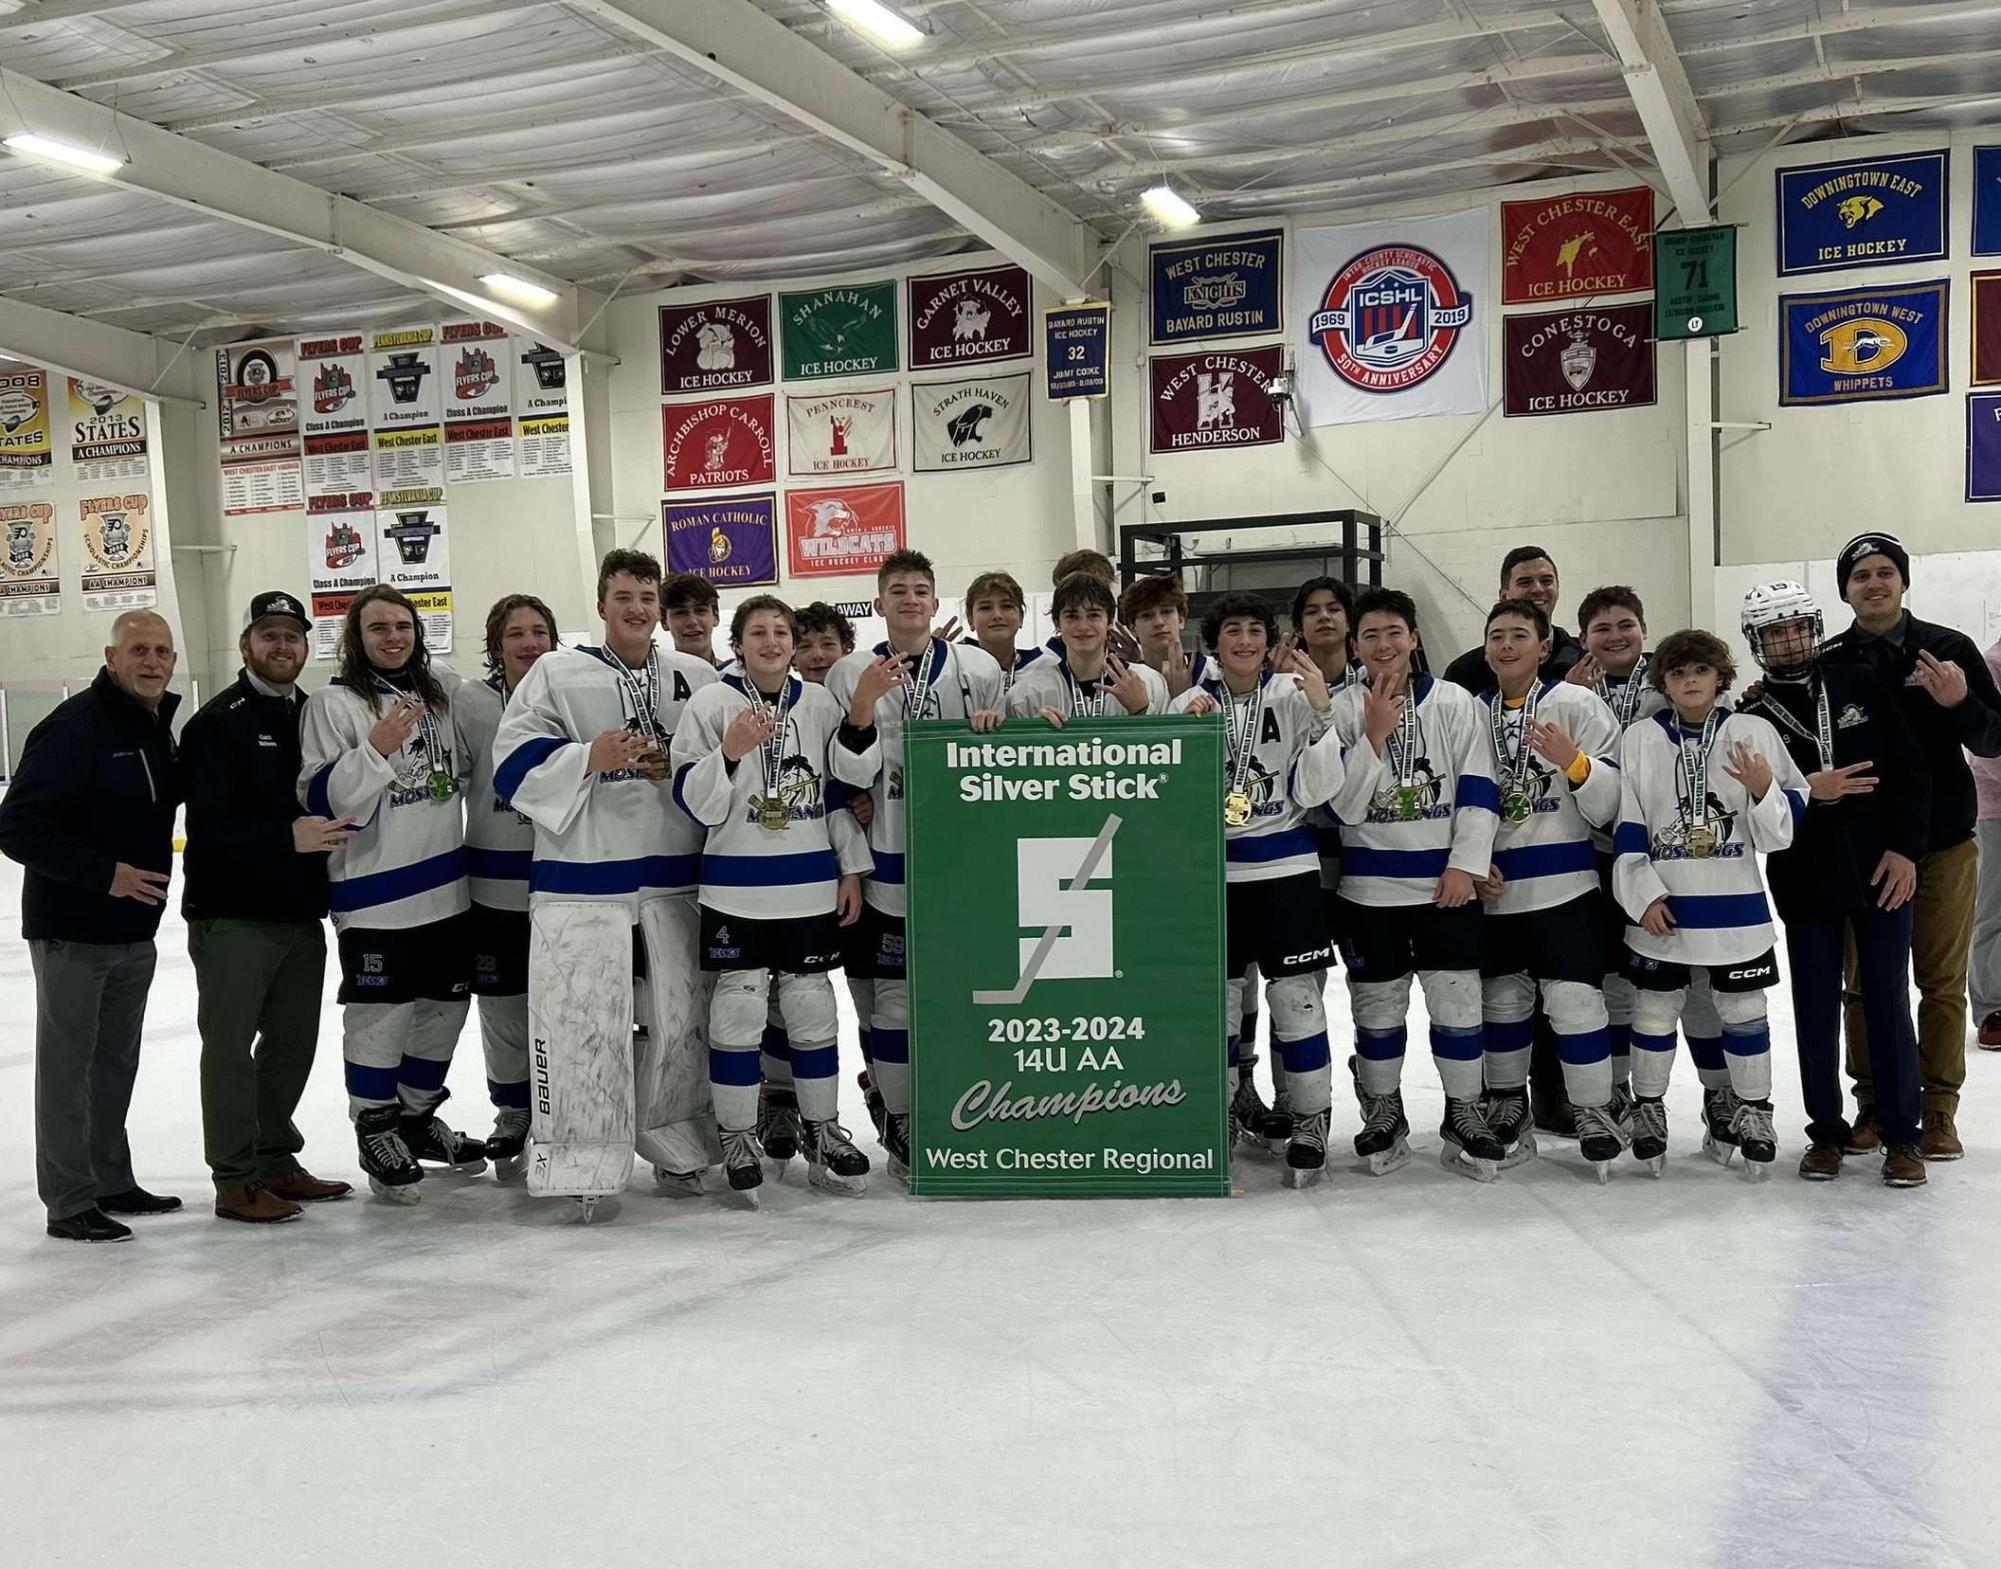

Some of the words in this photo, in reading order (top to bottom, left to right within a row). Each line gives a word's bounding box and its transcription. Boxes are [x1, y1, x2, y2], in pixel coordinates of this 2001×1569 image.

[1801, 172, 1887, 210] DOWNINGTOWN
[1890, 173, 1923, 199] EAST
[1506, 223, 1536, 268] WEST
[1537, 199, 1617, 226] CHESTER
[1618, 214, 1650, 254] EAST
[1818, 246, 1842, 261] ICE
[1847, 238, 1908, 257] HOCKEY
[1165, 256, 1200, 280] WEST
[1205, 251, 1266, 269] CHESTER
[1681, 260, 1709, 290] 71
[1187, 282, 1245, 301] KNIGHTS
[1528, 283, 1554, 297] ICE
[1559, 274, 1627, 293] HOCKEY
[916, 280, 968, 330] GARNET
[974, 279, 1022, 318] VALLEY
[1359, 288, 1422, 307] ICSHL
[793, 291, 882, 326] SHANAHAN
[1434, 309, 1465, 324] 2019
[1804, 302, 1887, 334] DOWNINGTOWN
[1892, 305, 1924, 325] WEST
[1166, 314, 1213, 333] BAYARD
[1218, 310, 1264, 327] RUSTIN
[1315, 314, 1345, 329] 1969
[666, 311, 706, 356] LOWER
[715, 307, 766, 348] MERION
[1521, 315, 1637, 358] CONESTOGA
[339, 336, 362, 351] CUP
[930, 346, 952, 360] ICE
[955, 338, 1011, 356] HOCKEY
[1068, 346, 1085, 360] 32
[220, 353, 228, 384] 2013
[801, 363, 821, 375] ICE
[824, 357, 878, 373] HOCKEY
[1337, 355, 1360, 374] 50TH
[1361, 344, 1443, 386] ANNIVERSARY
[456, 373, 479, 387] FLYERS
[680, 375, 700, 389] ICE
[702, 370, 753, 387] HOCKEY
[1160, 363, 1198, 402] WEST
[1204, 356, 1271, 394] CHESTER
[1833, 376, 1894, 392] WHIPPETS
[315, 388, 338, 401] FLYERS
[534, 398, 567, 408] Champi
[933, 388, 972, 416] STRATH
[975, 387, 1010, 410] HAVEN
[1529, 395, 1555, 411] ICE
[1560, 389, 1630, 407] HOCKEY
[389, 411, 428, 421] Champion
[473, 405, 508, 416] Champion
[806, 397, 876, 418] PENNCREST
[90, 414, 122, 425] 2013
[222, 404, 230, 432] 2012
[331, 419, 364, 430] Champion
[0, 431, 43, 447] TATES
[75, 416, 140, 443] STATES
[467, 428, 492, 438] Chester
[494, 427, 508, 437] East
[523, 425, 540, 436] West
[1171, 427, 1261, 446] HENDERSON
[78, 448, 85, 458] A
[85, 442, 141, 457] CHAMPIONS
[230, 447, 236, 455] A
[240, 440, 292, 453] CHAMPIONS
[378, 438, 394, 448] West
[396, 435, 422, 447] Chester
[423, 433, 437, 444] East
[666, 404, 727, 477] ARCHBISHOP
[729, 407, 772, 468] CARROLL
[0, 455, 42, 465] HAMPIONS
[813, 459, 828, 470] ICE
[832, 457, 870, 469] HOCKEY
[942, 451, 957, 463] ICE
[960, 448, 1001, 461] HOCKEY
[264, 464, 276, 472] EAST
[690, 469, 749, 485] PATRIOTS
[80, 497, 121, 520] FLYERS
[123, 494, 148, 515] CUP
[349, 492, 372, 507] CUP
[0, 505, 28, 521] YERS
[29, 503, 53, 524] CUP
[671, 514, 710, 533] ROMAN
[712, 511, 768, 526] CATHOLIC
[800, 533, 896, 558] WILDCATS
[709, 565, 751, 577] HOCKEY
[828, 558, 859, 566] HOCKEY
[90, 580, 101, 588] AA
[102, 576, 147, 588] CHAMPIONS
[313, 579, 332, 588] Class
[333, 579, 339, 587] A
[340, 577, 376, 588] Champion
[397, 572, 439, 583] Champion
[408, 598, 431, 607] hester
[433, 597, 447, 607] East
[674, 670, 691, 701] A
[1261, 707, 1281, 744] A
[947, 738, 1182, 768] International
[959, 774, 1060, 802] Silver
[363, 953, 383, 973] 15
[1283, 947, 1331, 965] CCM
[1728, 965, 1771, 980] CCM
[988, 1016, 1145, 1043] 2023-2024
[1013, 1047, 1067, 1074] 14U
[1077, 1045, 1124, 1072] AA
[950, 1077, 1187, 1132] Champions
[926, 1148, 988, 1170] West
[996, 1147, 1096, 1170] Chester
[1103, 1147, 1214, 1174] Regional
